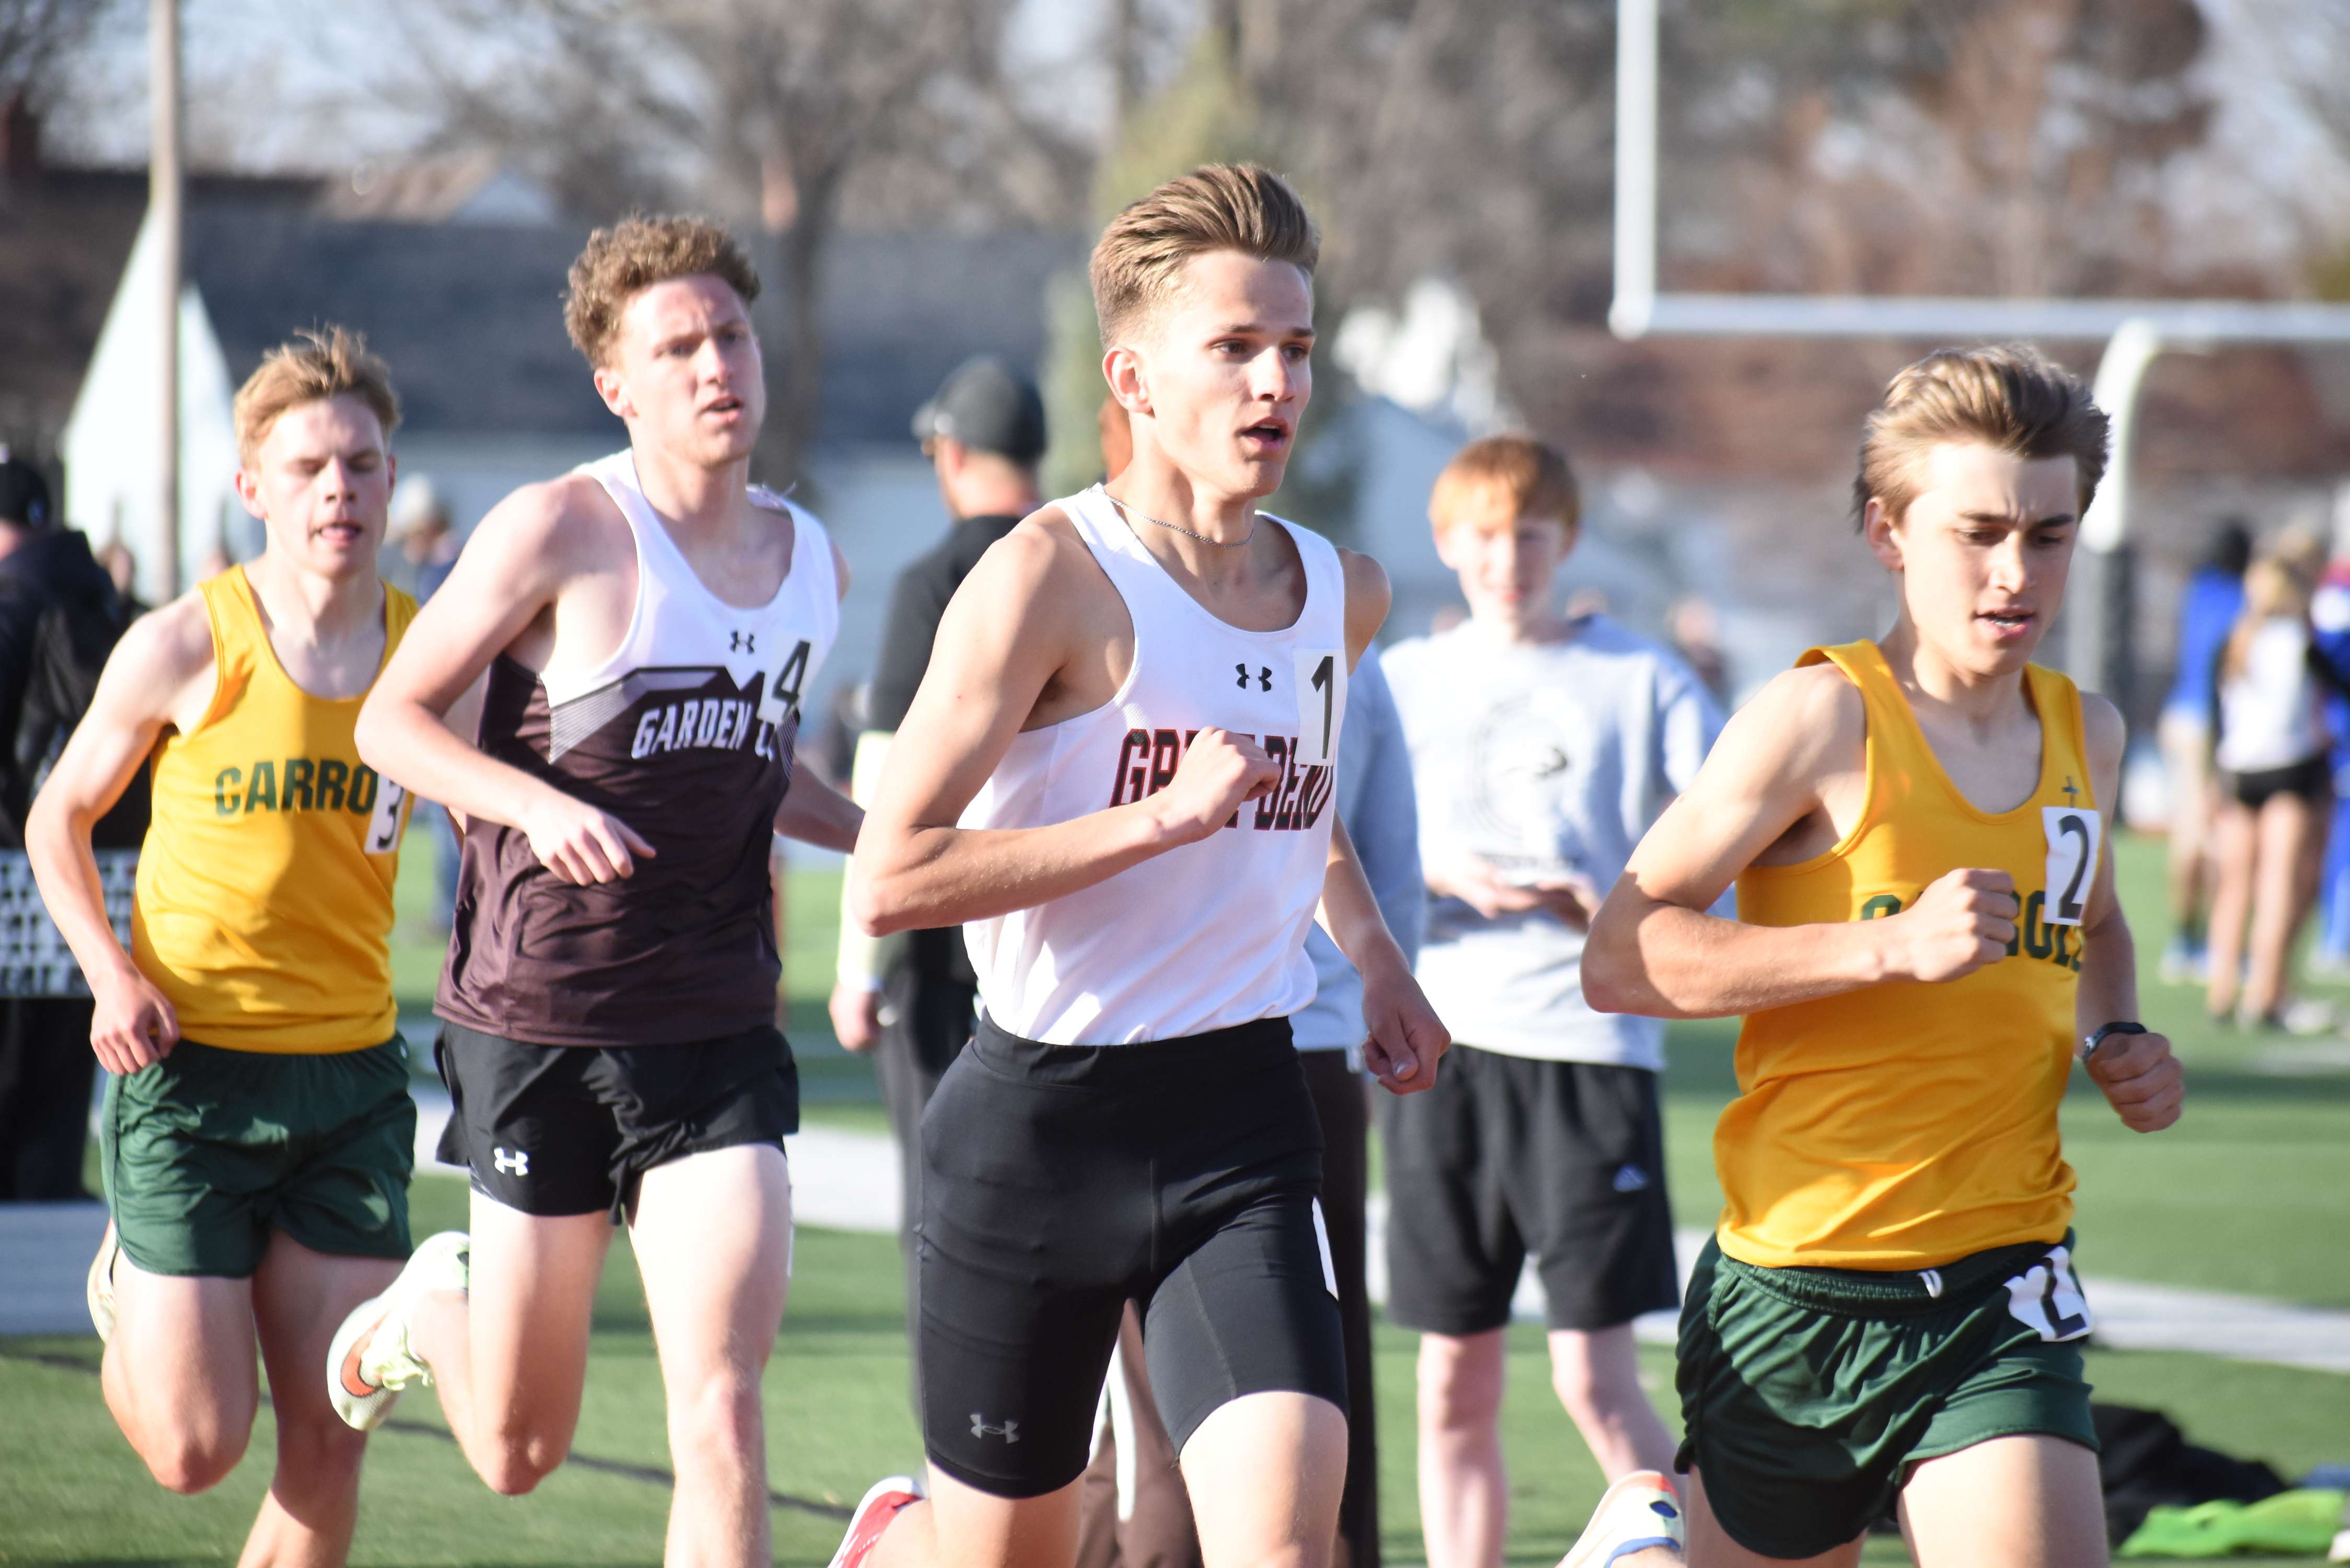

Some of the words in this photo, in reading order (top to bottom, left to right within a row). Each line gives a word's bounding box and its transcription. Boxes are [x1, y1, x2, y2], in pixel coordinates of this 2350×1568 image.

[772, 640, 811, 720] 4
[1311, 655, 1334, 759] 1
[630, 697, 753, 760] GARDEN
[2057, 815, 2089, 920] 2
